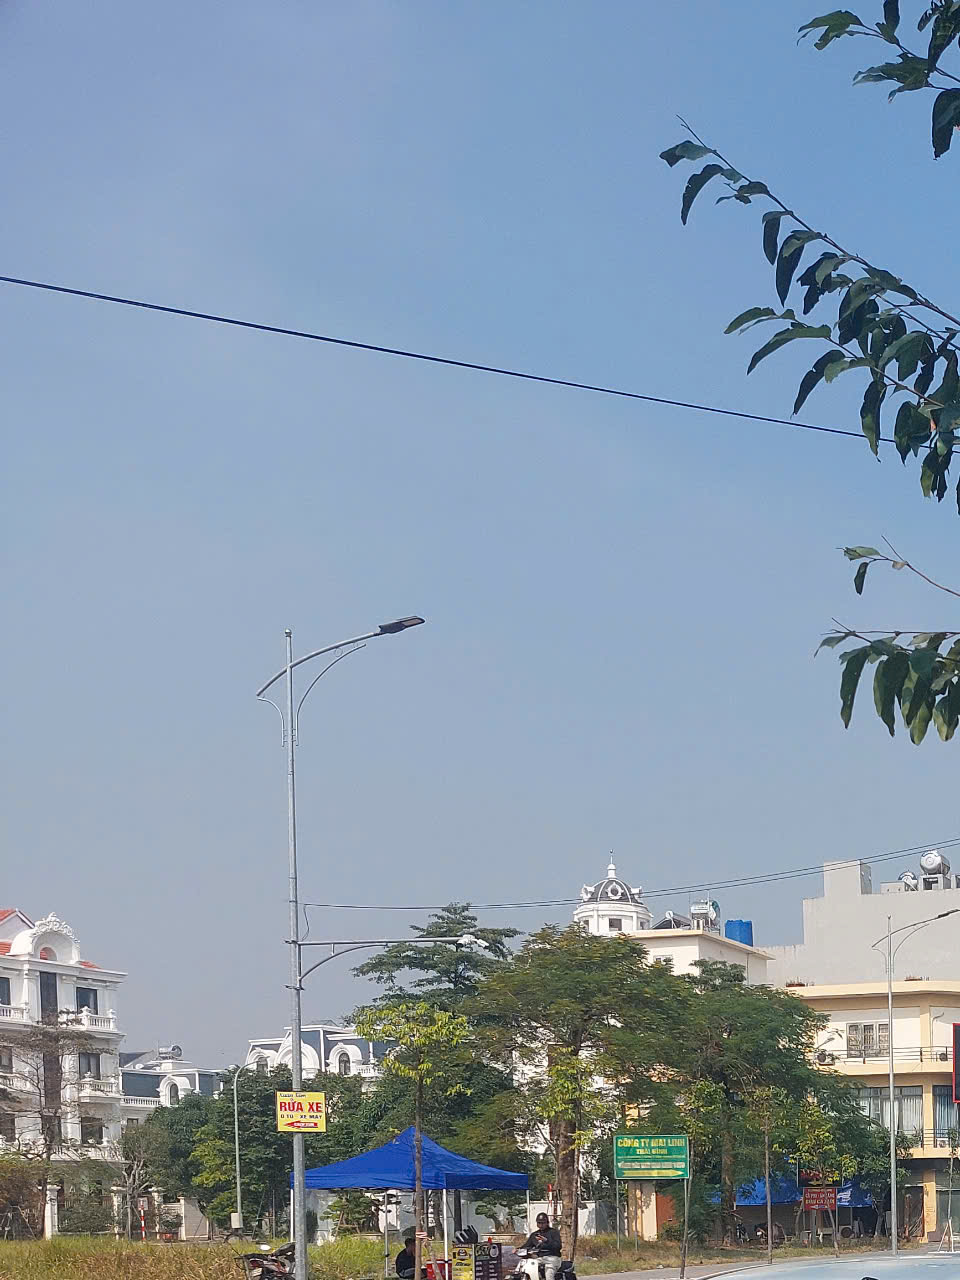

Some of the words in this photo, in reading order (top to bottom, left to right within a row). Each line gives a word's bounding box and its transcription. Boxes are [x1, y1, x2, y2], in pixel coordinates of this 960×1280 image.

[280, 1098, 303, 1111] RỬA
[308, 1101, 323, 1113] XE
[618, 1138, 639, 1148] CÔNG
[640, 1138, 649, 1147] TY
